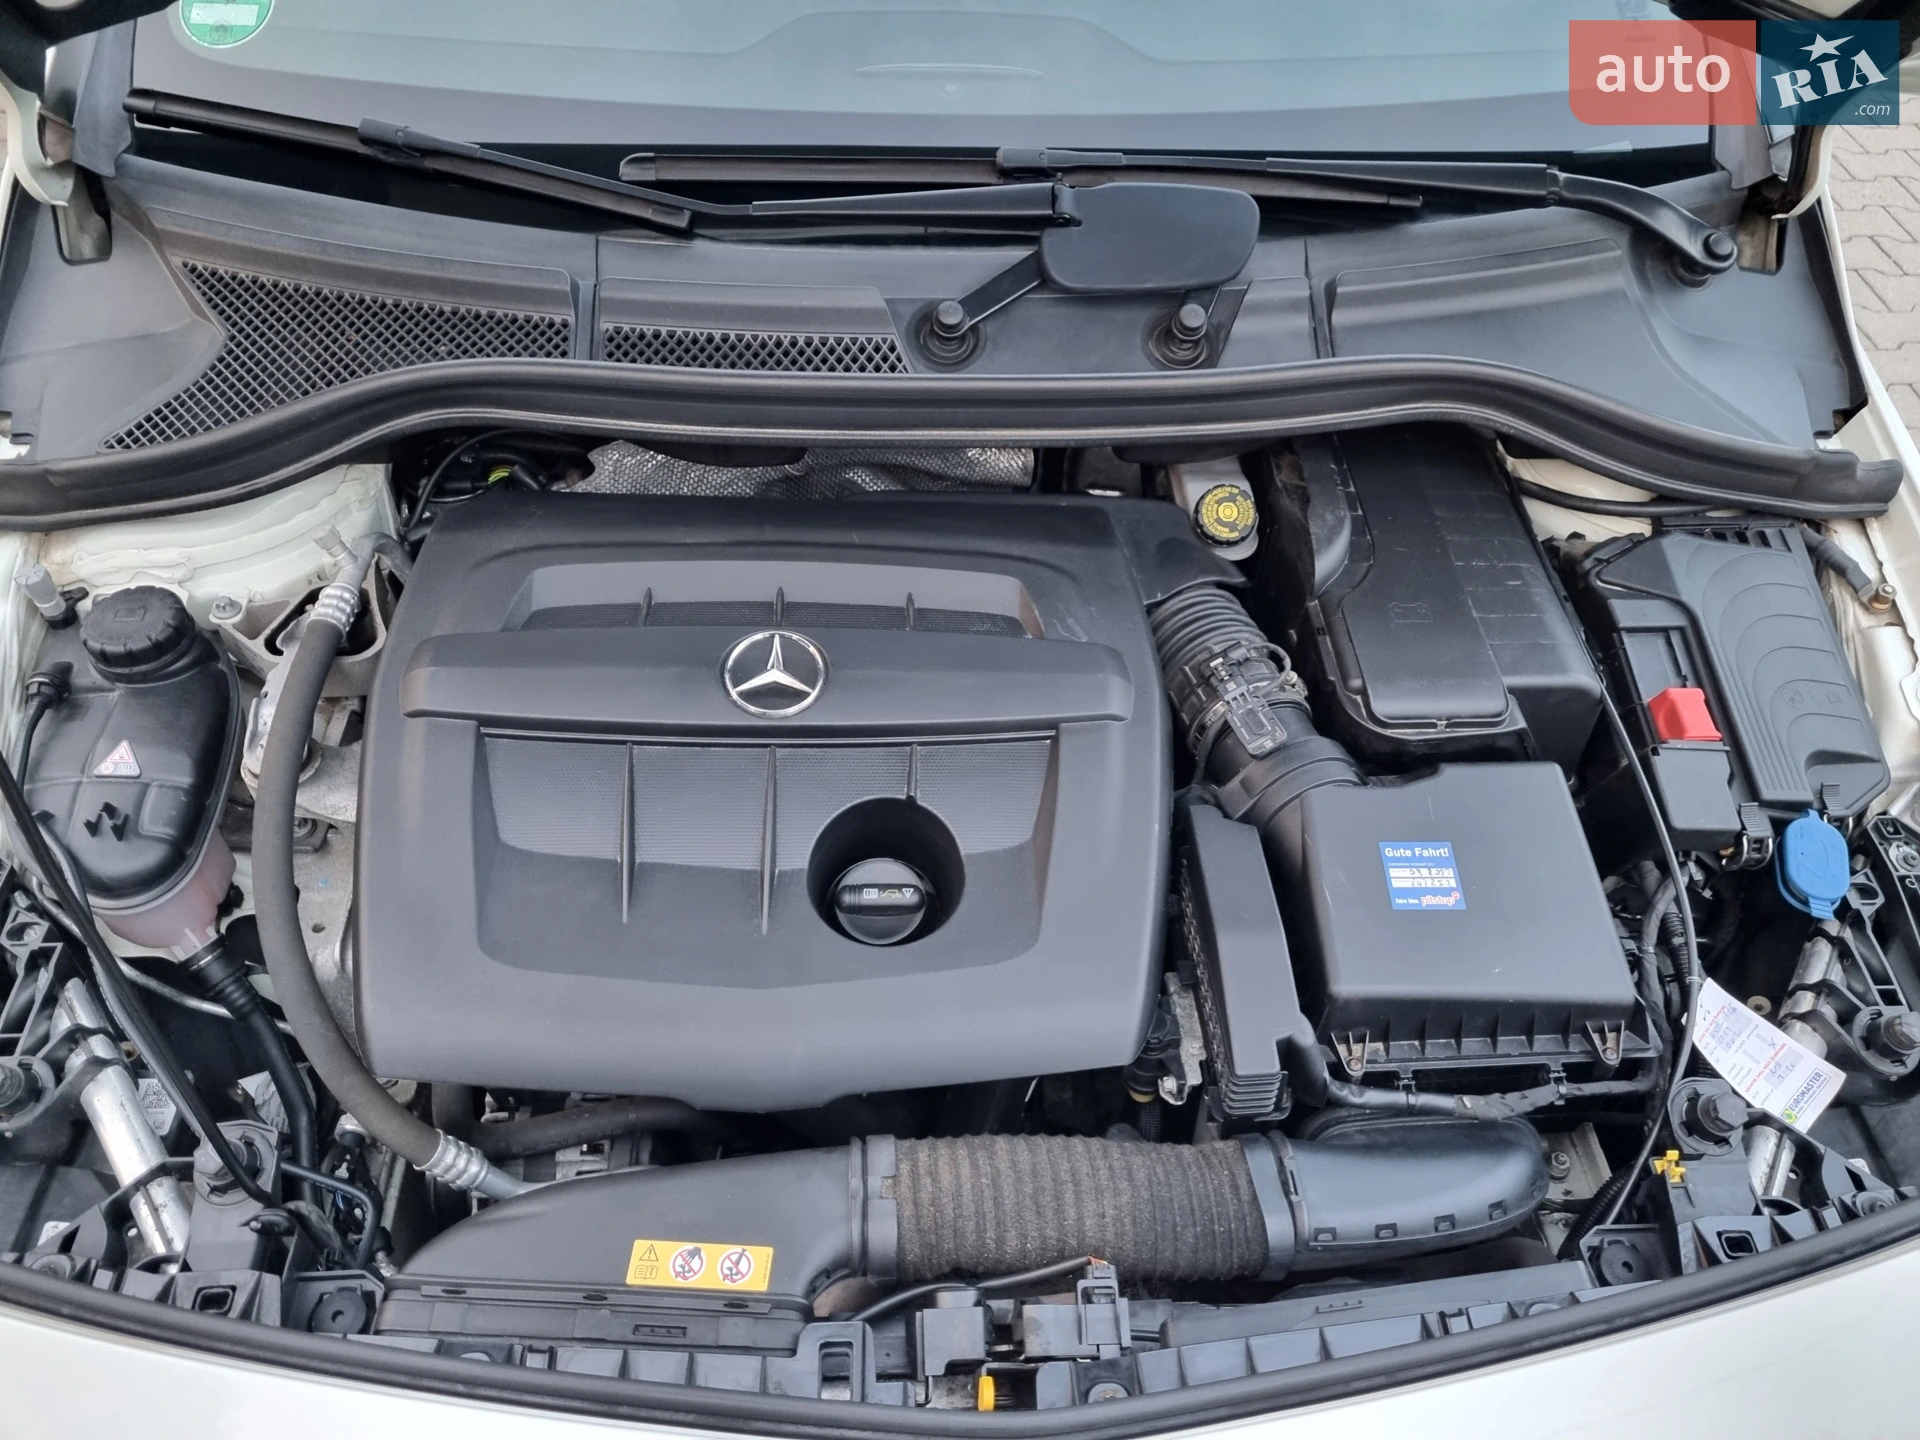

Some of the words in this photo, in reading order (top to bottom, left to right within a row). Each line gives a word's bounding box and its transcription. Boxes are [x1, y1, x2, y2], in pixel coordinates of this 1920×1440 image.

[1384, 847, 1412, 857] Gute
[1414, 847, 1449, 857] Fahrt!
[1788, 1071, 1823, 1112] EUROMASTER
